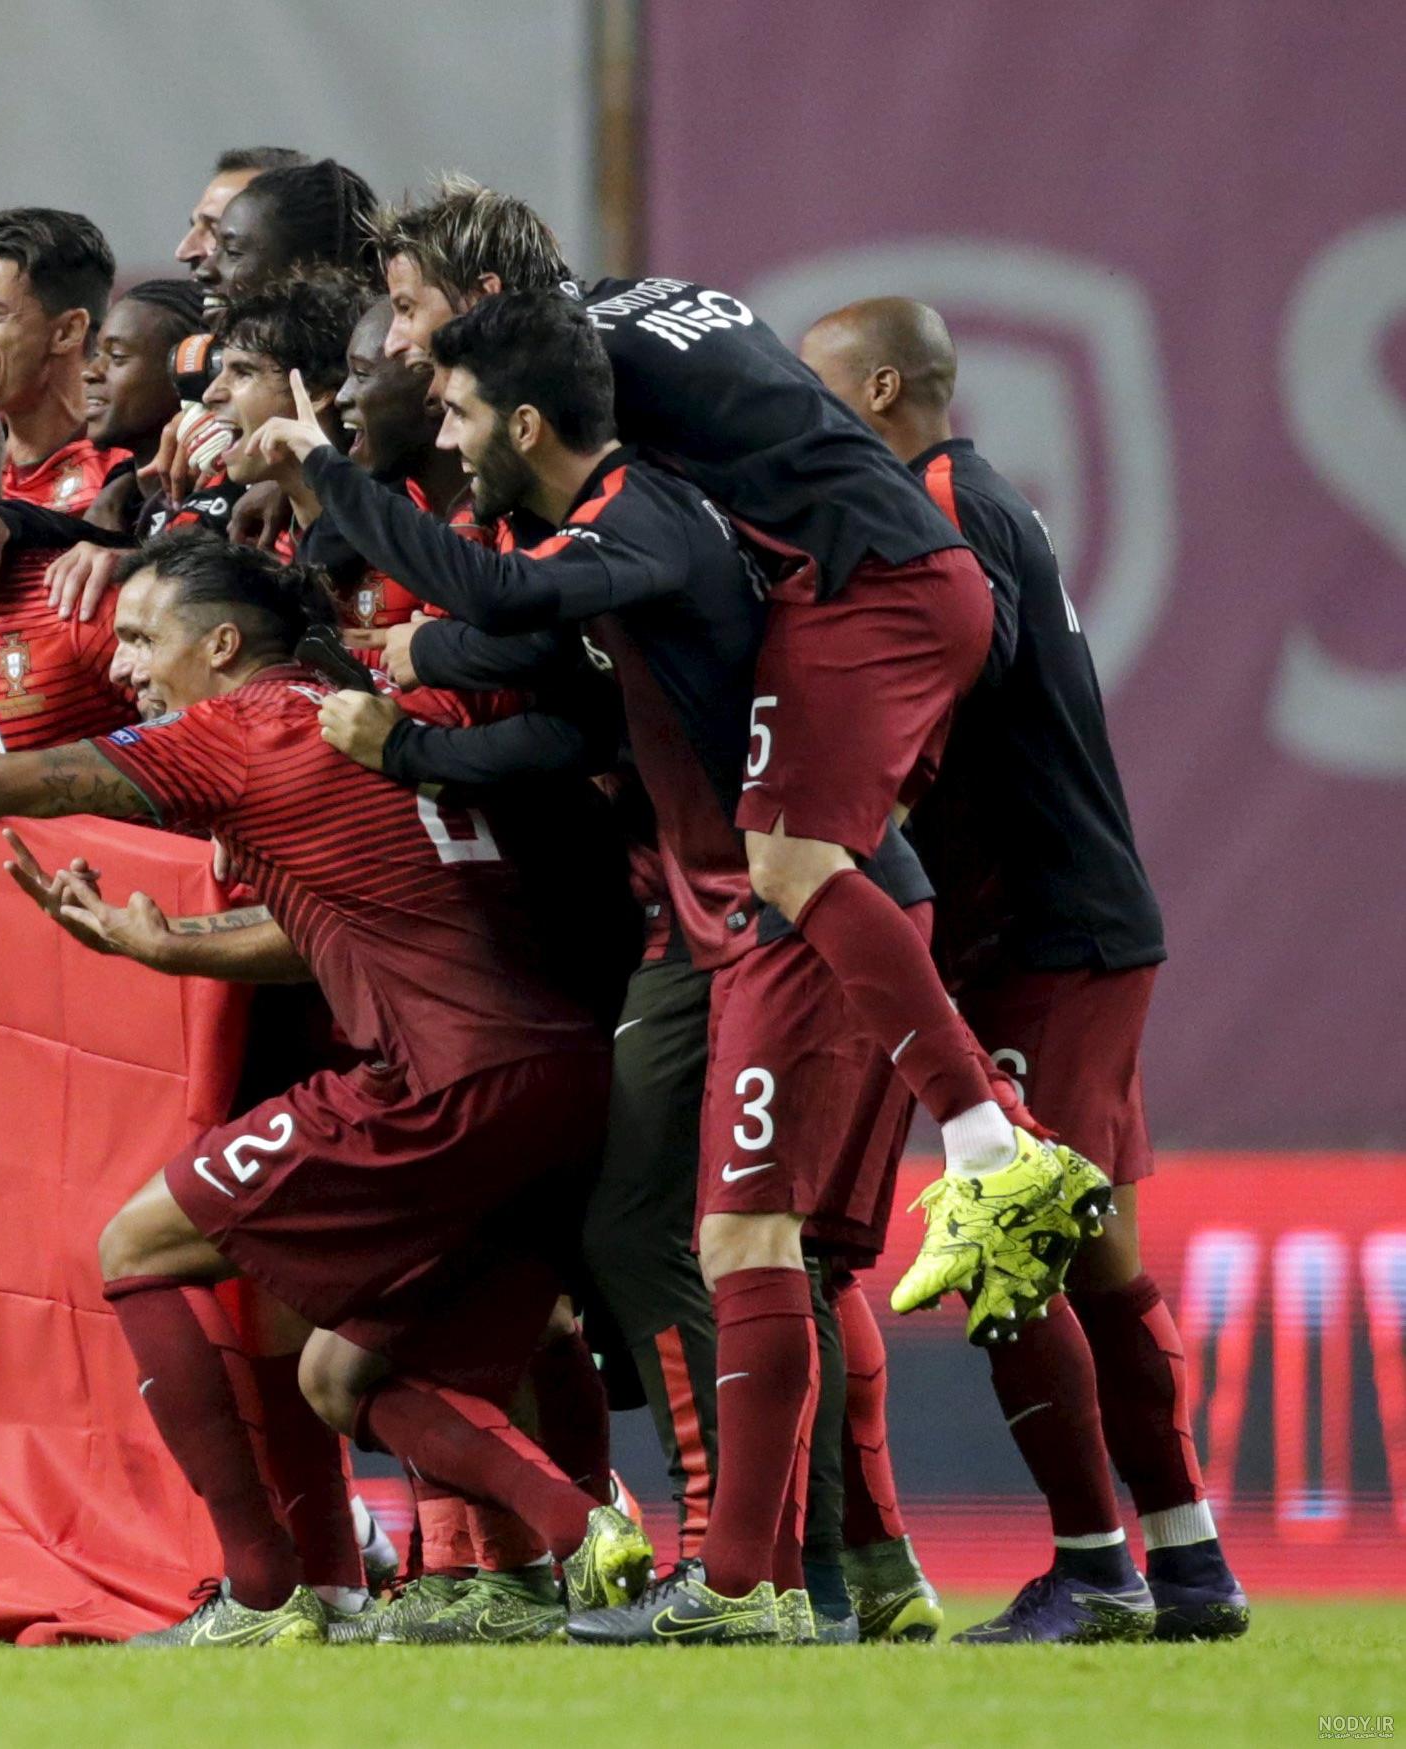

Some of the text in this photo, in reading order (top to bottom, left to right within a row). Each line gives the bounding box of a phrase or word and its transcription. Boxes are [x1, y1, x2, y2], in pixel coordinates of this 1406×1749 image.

[747, 695, 778, 777] 5
[222, 1112, 294, 1184] 2
[733, 1067, 775, 1151] 3
